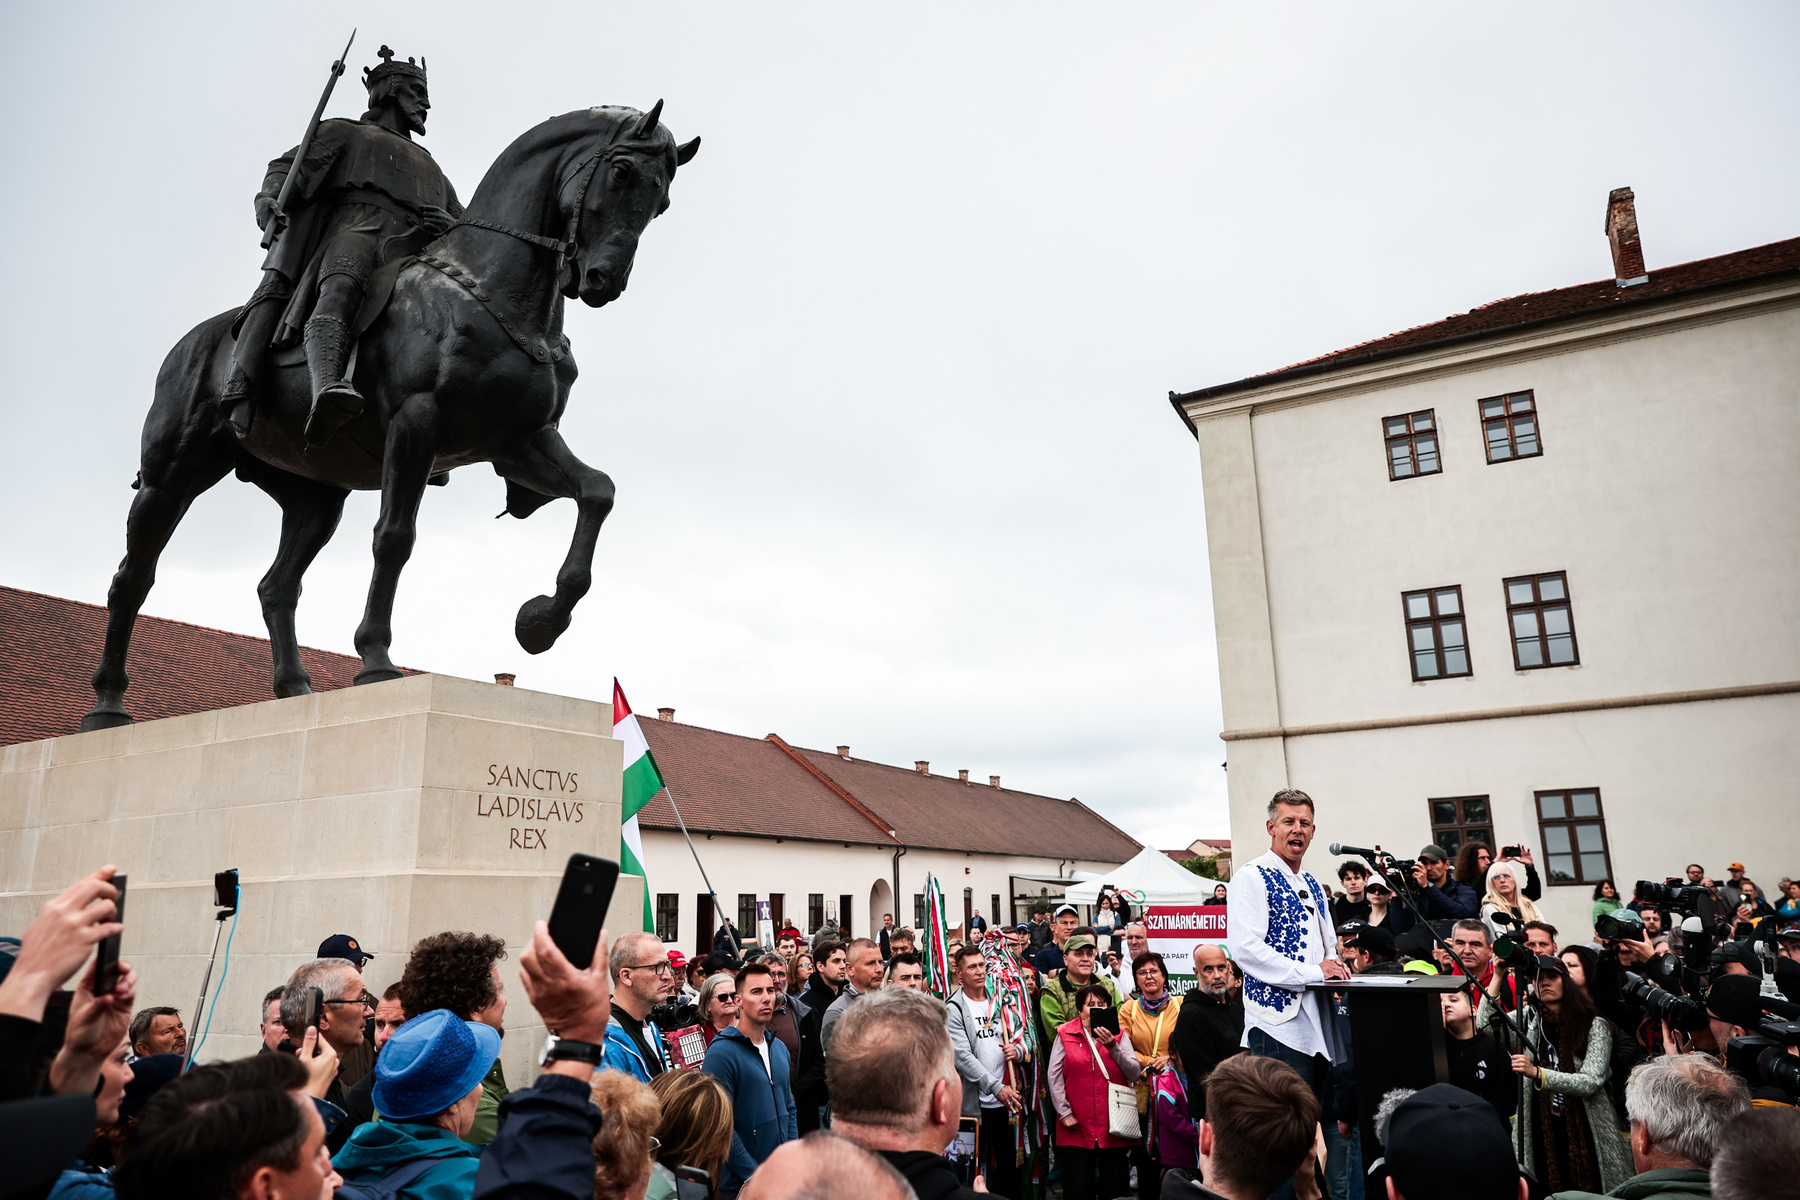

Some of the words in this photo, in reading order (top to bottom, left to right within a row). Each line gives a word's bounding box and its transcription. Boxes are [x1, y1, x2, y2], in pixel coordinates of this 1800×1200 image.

[487, 764, 578, 793] SANCTVS
[477, 794, 584, 823] LADISLAVS
[509, 827, 547, 850] REX
[1148, 913, 1216, 930] SZATMÁRNÉMETI
[1218, 914, 1226, 930] IS
